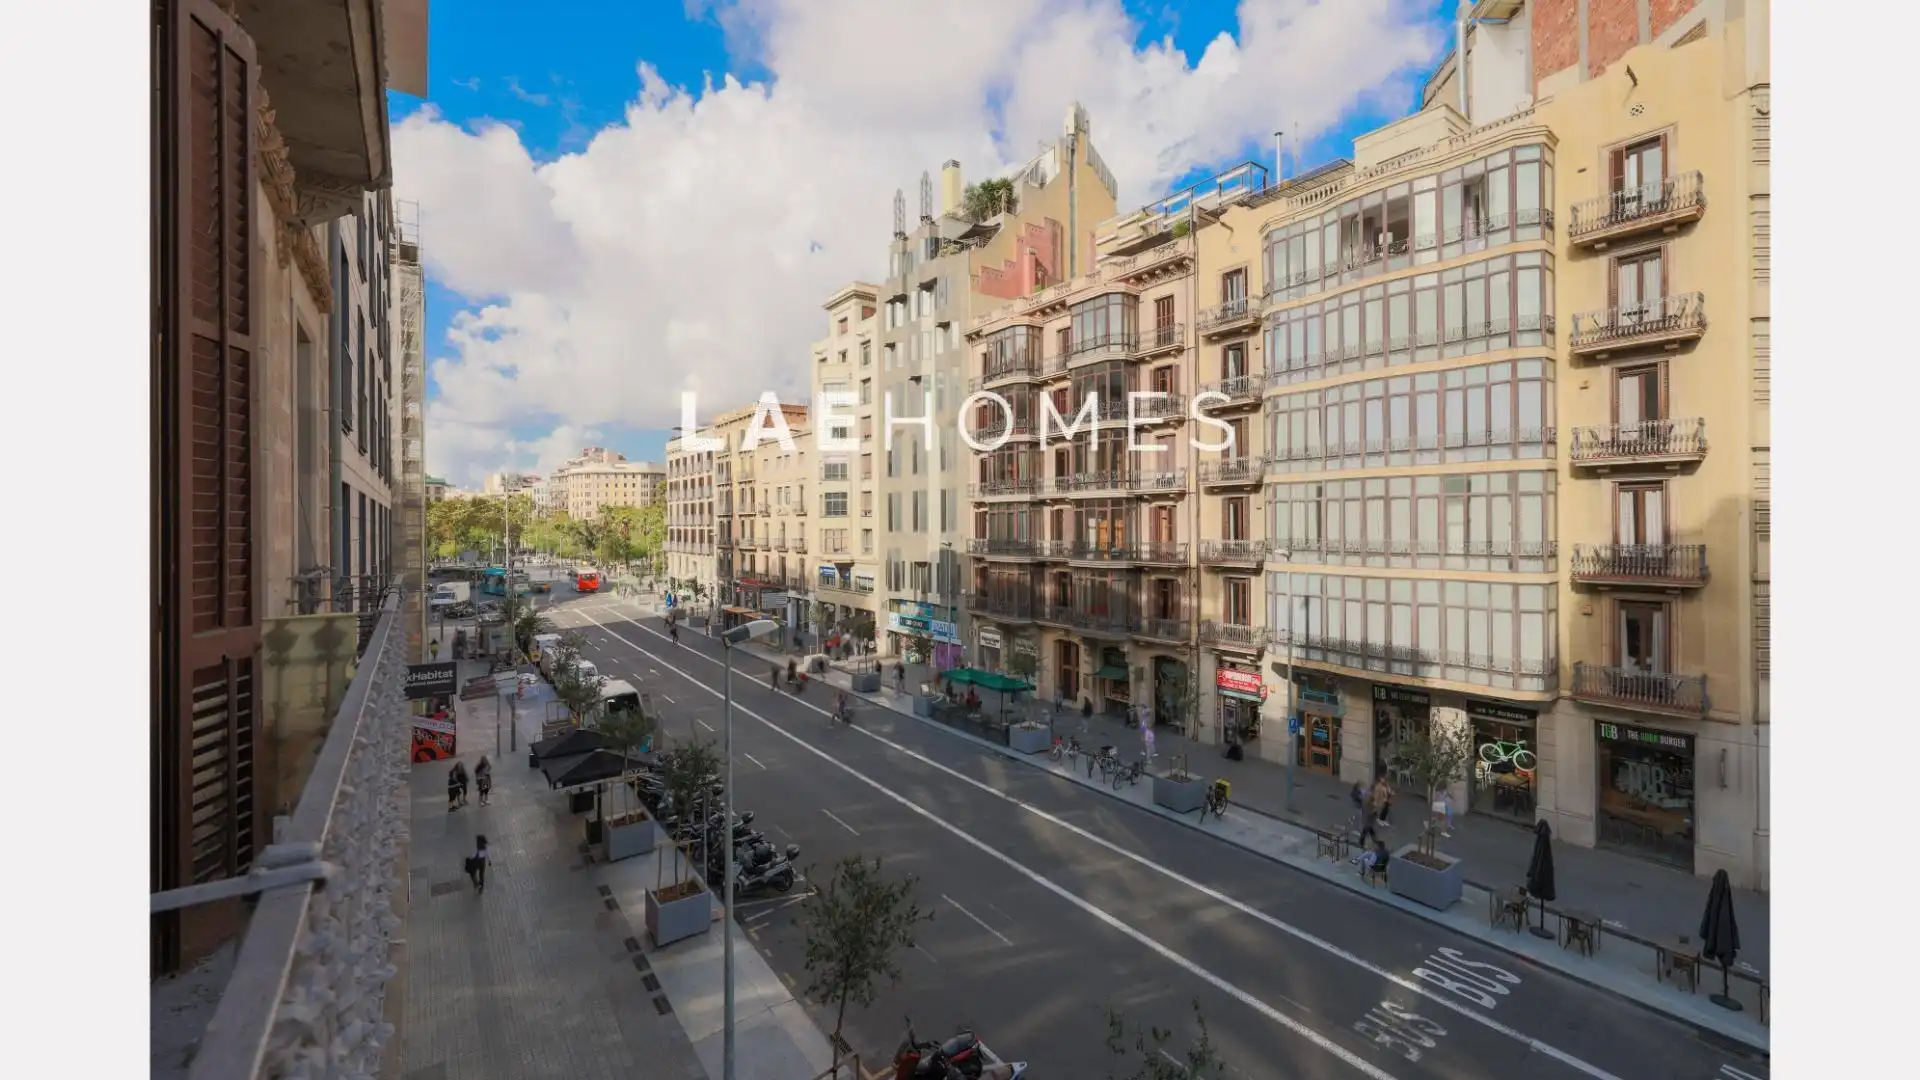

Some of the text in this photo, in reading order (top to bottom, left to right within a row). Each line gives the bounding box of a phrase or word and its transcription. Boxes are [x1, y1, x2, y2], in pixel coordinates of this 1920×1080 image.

[1600, 723, 1618, 740] TGB
[1627, 729, 1639, 741] THE
[1412, 946, 1522, 1010] BUS
